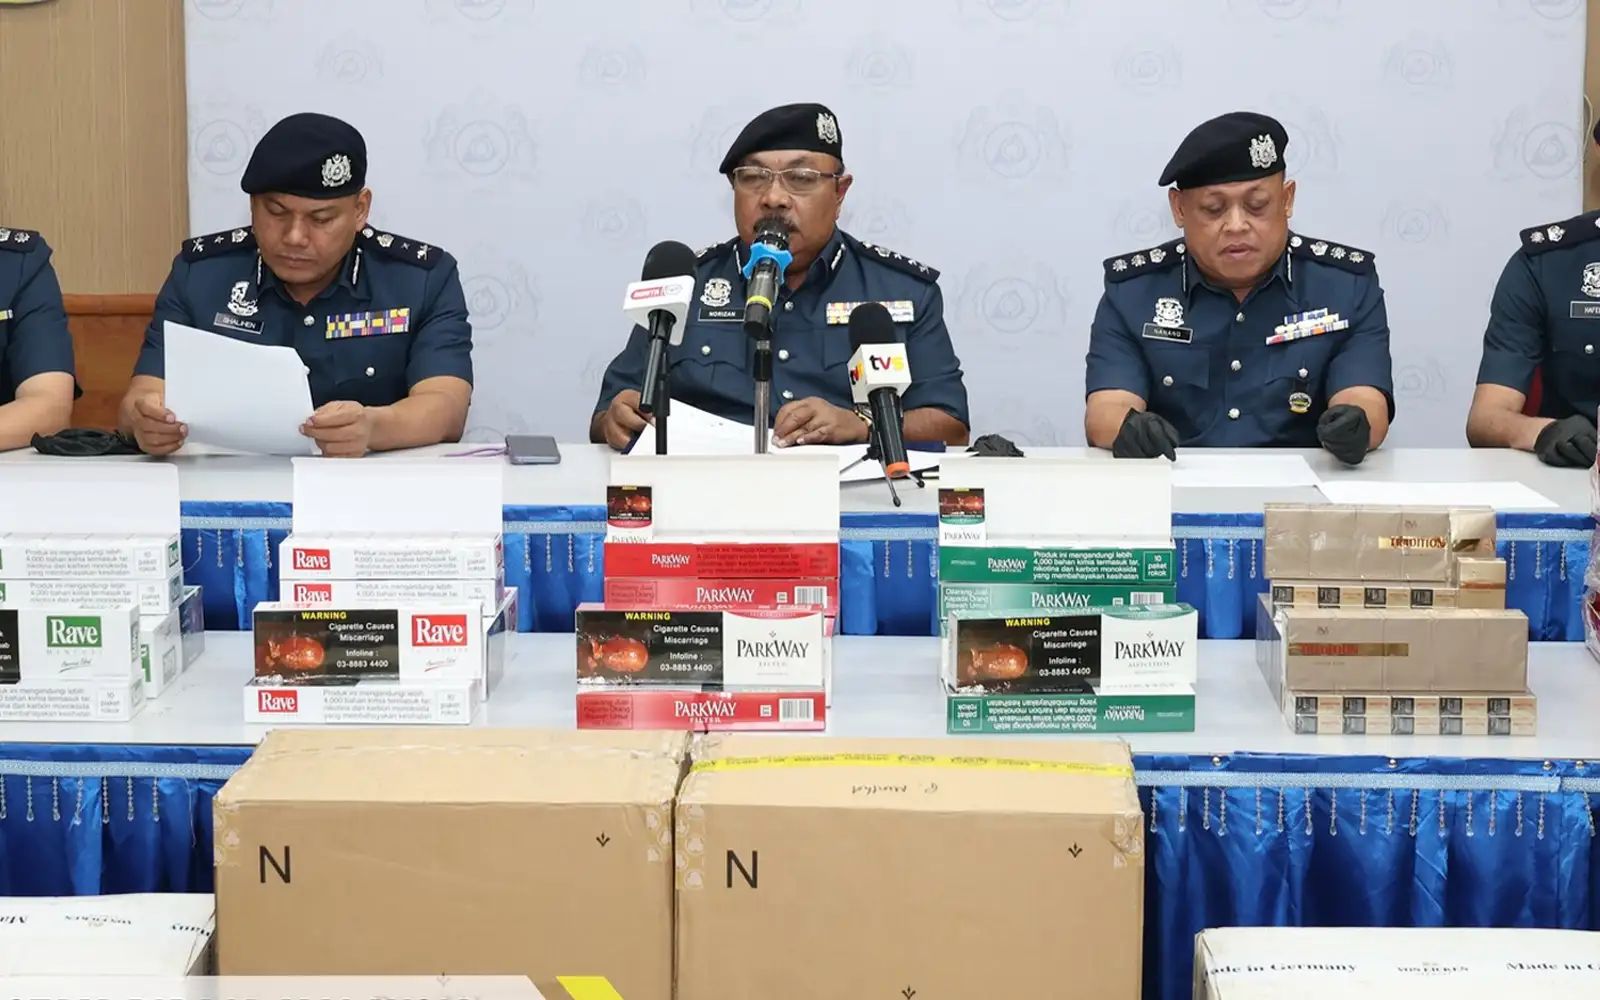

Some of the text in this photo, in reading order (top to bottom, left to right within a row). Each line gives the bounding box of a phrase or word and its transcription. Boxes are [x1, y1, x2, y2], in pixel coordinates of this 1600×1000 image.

[1390, 537, 1446, 548] TRADITION
[295, 550, 328, 568] Rave
[652, 554, 690, 564] PARKWAY
[1034, 551, 1132, 559] Produk ini mengandungi lebih
[987, 558, 1028, 570] PARKWAY
[297, 586, 329, 601] Rave
[697, 587, 755, 603] PARKWAY
[1031, 592, 1091, 607] PARKWAY
[301, 612, 347, 620] WARNING
[625, 613, 671, 621] WARNING
[328, 623, 395, 631] Cigarette Causes
[1005, 618, 1051, 627] WARNING
[50, 618, 98, 644] Rave
[416, 618, 464, 643] Rave
[653, 625, 720, 633] Cigarette Causes
[1032, 629, 1097, 639] Cigarette Causes
[340, 633, 384, 642] Miscarriage
[664, 637, 708, 645] Miscarriage
[737, 640, 808, 658] PARKWAY
[1043, 640, 1087, 649] Miscarriage
[1115, 640, 1184, 659] PARKWAY
[1039, 667, 1091, 676] 03-8883 4400
[261, 692, 296, 711] Rave
[674, 700, 736, 718] PARKWAY
[1103, 709, 1144, 721] PARKWAY
[260, 846, 291, 884] N
[726, 851, 758, 888] N
[1270, 964, 1356, 974] Germany
[1506, 962, 1557, 971] Made
[1564, 962, 1582, 971] in
